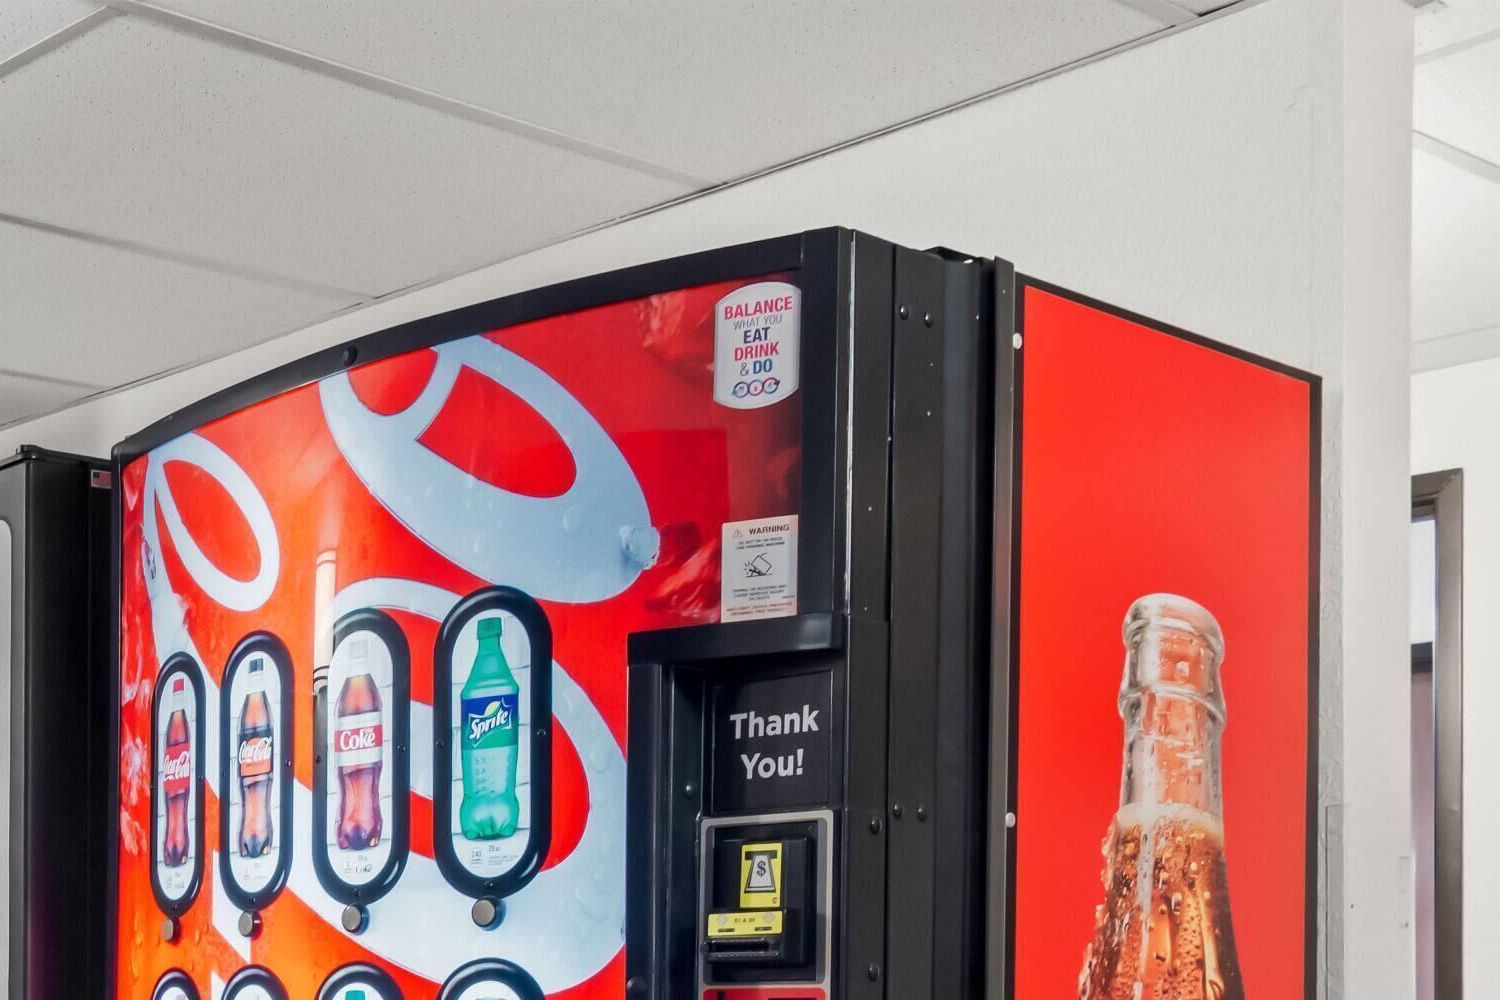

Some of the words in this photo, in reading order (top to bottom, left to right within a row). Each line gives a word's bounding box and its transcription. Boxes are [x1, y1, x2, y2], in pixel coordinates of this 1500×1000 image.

[724, 296, 793, 320] BALANCE
[733, 318, 760, 330] WHAT
[764, 314, 783, 325] YOU
[743, 327, 771, 344] EAT
[734, 342, 780, 361] DRINK
[740, 362, 749, 376] &
[753, 359, 773, 374] DO
[749, 524, 790, 535] WARNING
[469, 708, 508, 740] Sprite
[729, 704, 820, 739] Thank
[340, 728, 375, 750] Coke
[740, 748, 804, 780] You!
